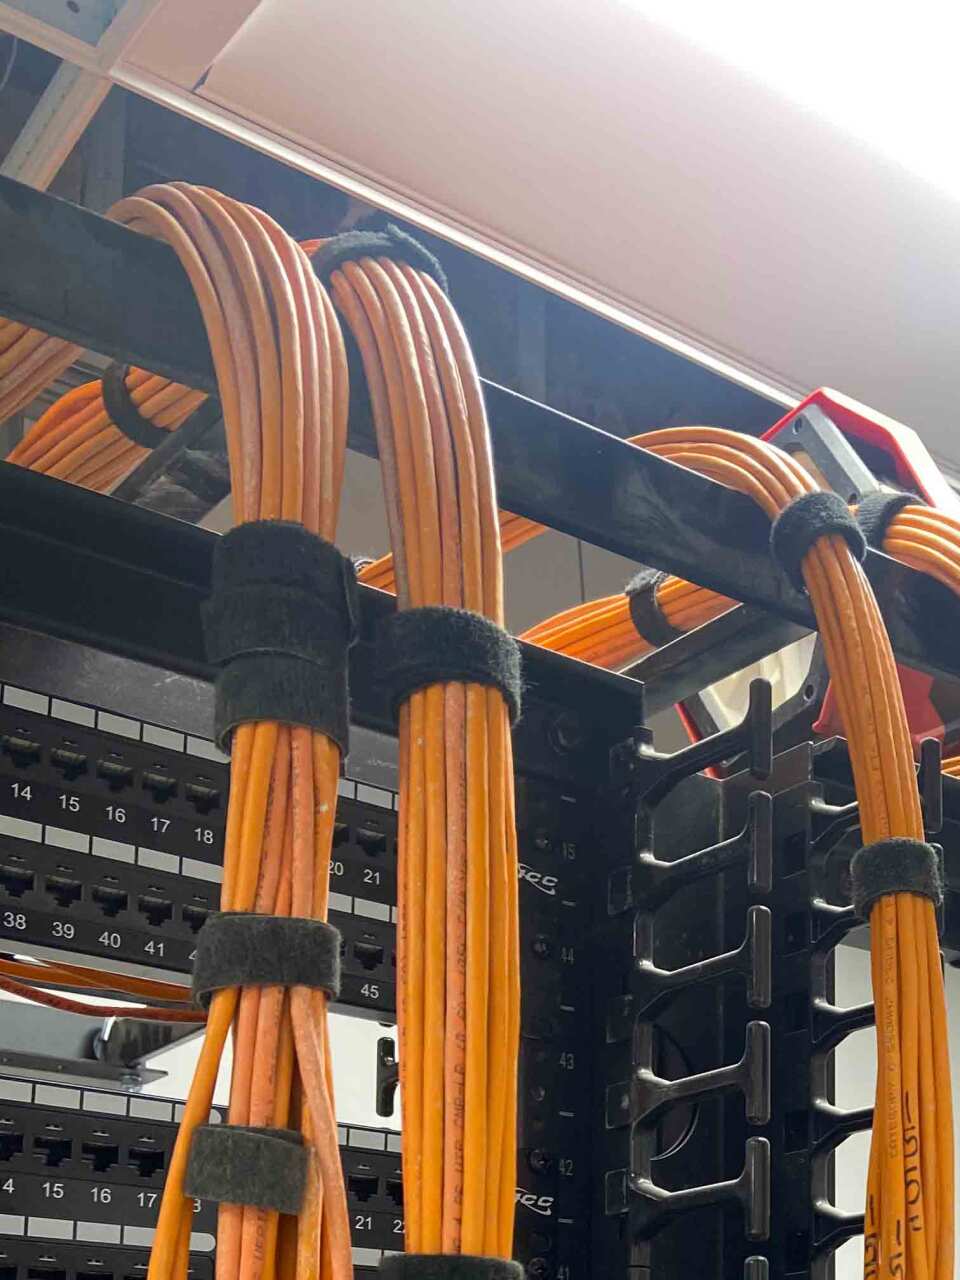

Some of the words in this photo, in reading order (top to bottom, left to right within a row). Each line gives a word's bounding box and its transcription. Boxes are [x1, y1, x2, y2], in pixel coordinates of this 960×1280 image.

[11, 783, 32, 801] 14
[59, 794, 80, 812] 15
[105, 806, 126, 823] 16
[151, 818, 170, 833] 17
[194, 827, 214, 844] 18
[328, 862, 344, 876] 20
[363, 869, 380, 886] 21
[3, 911, 26, 930] 38
[52, 921, 75, 939] 39
[99, 931, 121, 948] 40
[144, 941, 165, 957] 41
[361, 983, 379, 999] 45
[560, 946, 575, 965] 44
[559, 1052, 574, 1070] 43
[559, 1159, 574, 1177] 42
[42, 1182, 65, 1199] 15
[90, 1186, 112, 1203] 16
[136, 1192, 158, 1208] 17
[355, 1215, 372, 1230] 21
